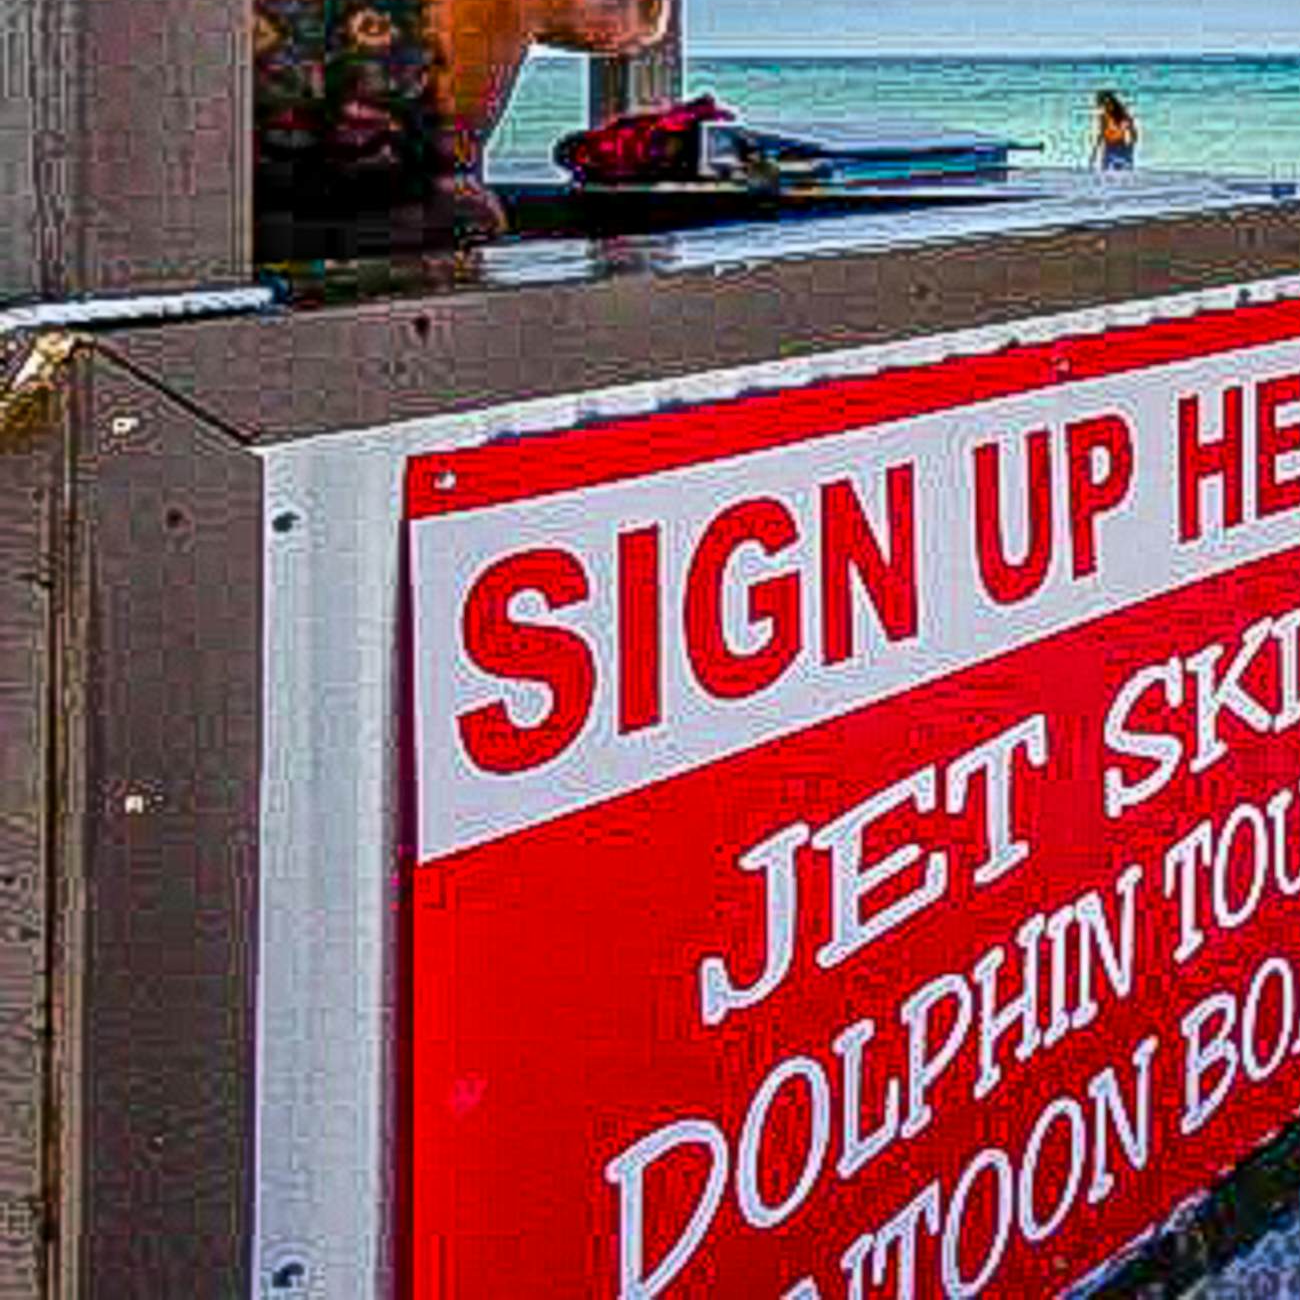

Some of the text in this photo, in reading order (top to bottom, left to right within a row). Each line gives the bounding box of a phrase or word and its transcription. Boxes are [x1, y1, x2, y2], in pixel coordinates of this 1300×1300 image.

[456, 462, 919, 775] SIGN
[973, 414, 1135, 606] UP
[700, 715, 1047, 1026] JET
[605, 864, 1144, 1300] DOLPHIN
